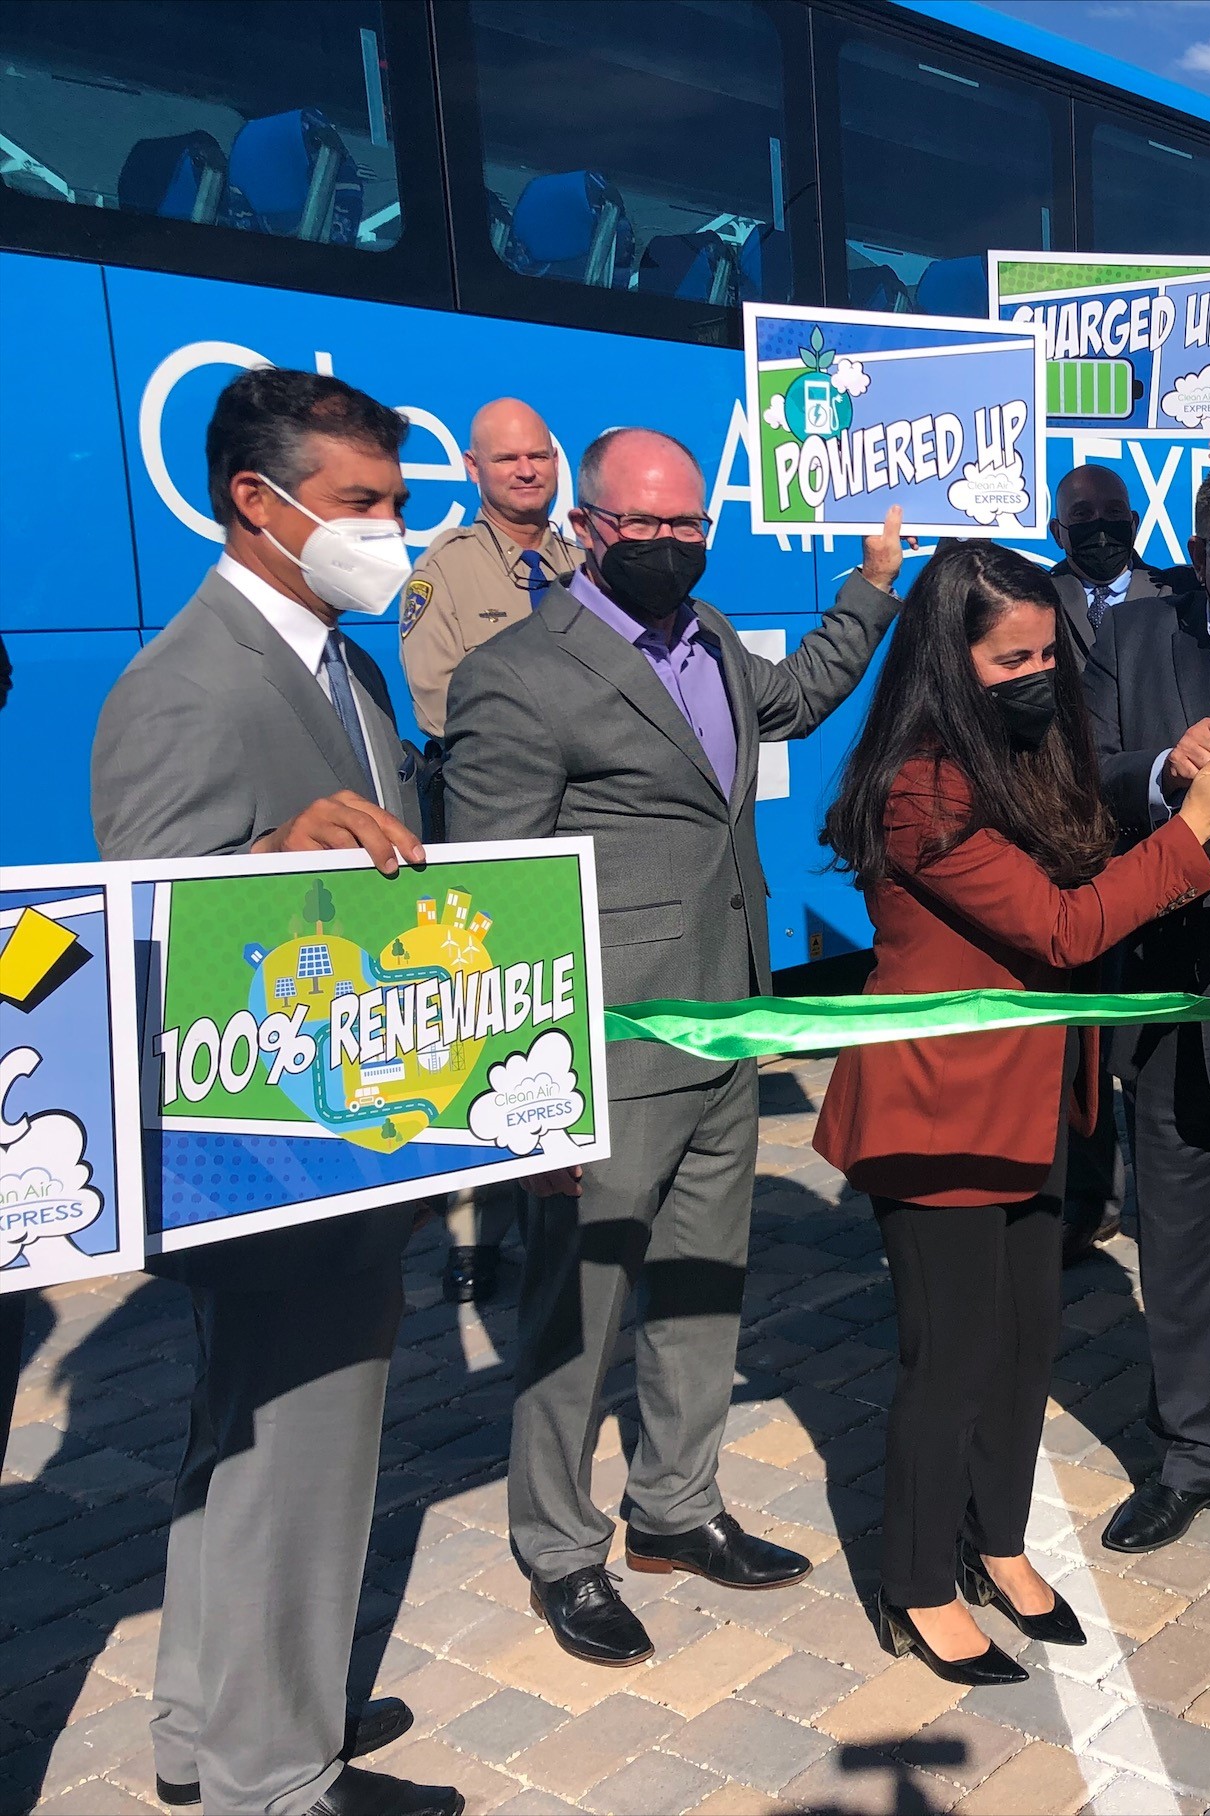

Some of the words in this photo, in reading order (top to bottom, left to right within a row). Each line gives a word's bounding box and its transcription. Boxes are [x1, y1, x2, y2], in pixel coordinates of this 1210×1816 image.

[774, 412, 964, 513] POWERED
[974, 399, 1028, 473] UP
[967, 481, 995, 490] Clean
[974, 494, 1022, 504] EXPRESS
[153, 1004, 317, 1107] 100%
[330, 952, 576, 1071] RENEWABLE
[494, 1090, 534, 1107] Clean
[536, 1084, 554, 1099] Air
[506, 1101, 573, 1127] EXPRESS
[24, 1181, 52, 1200] Air
[0, 1202, 83, 1231] PRESS
